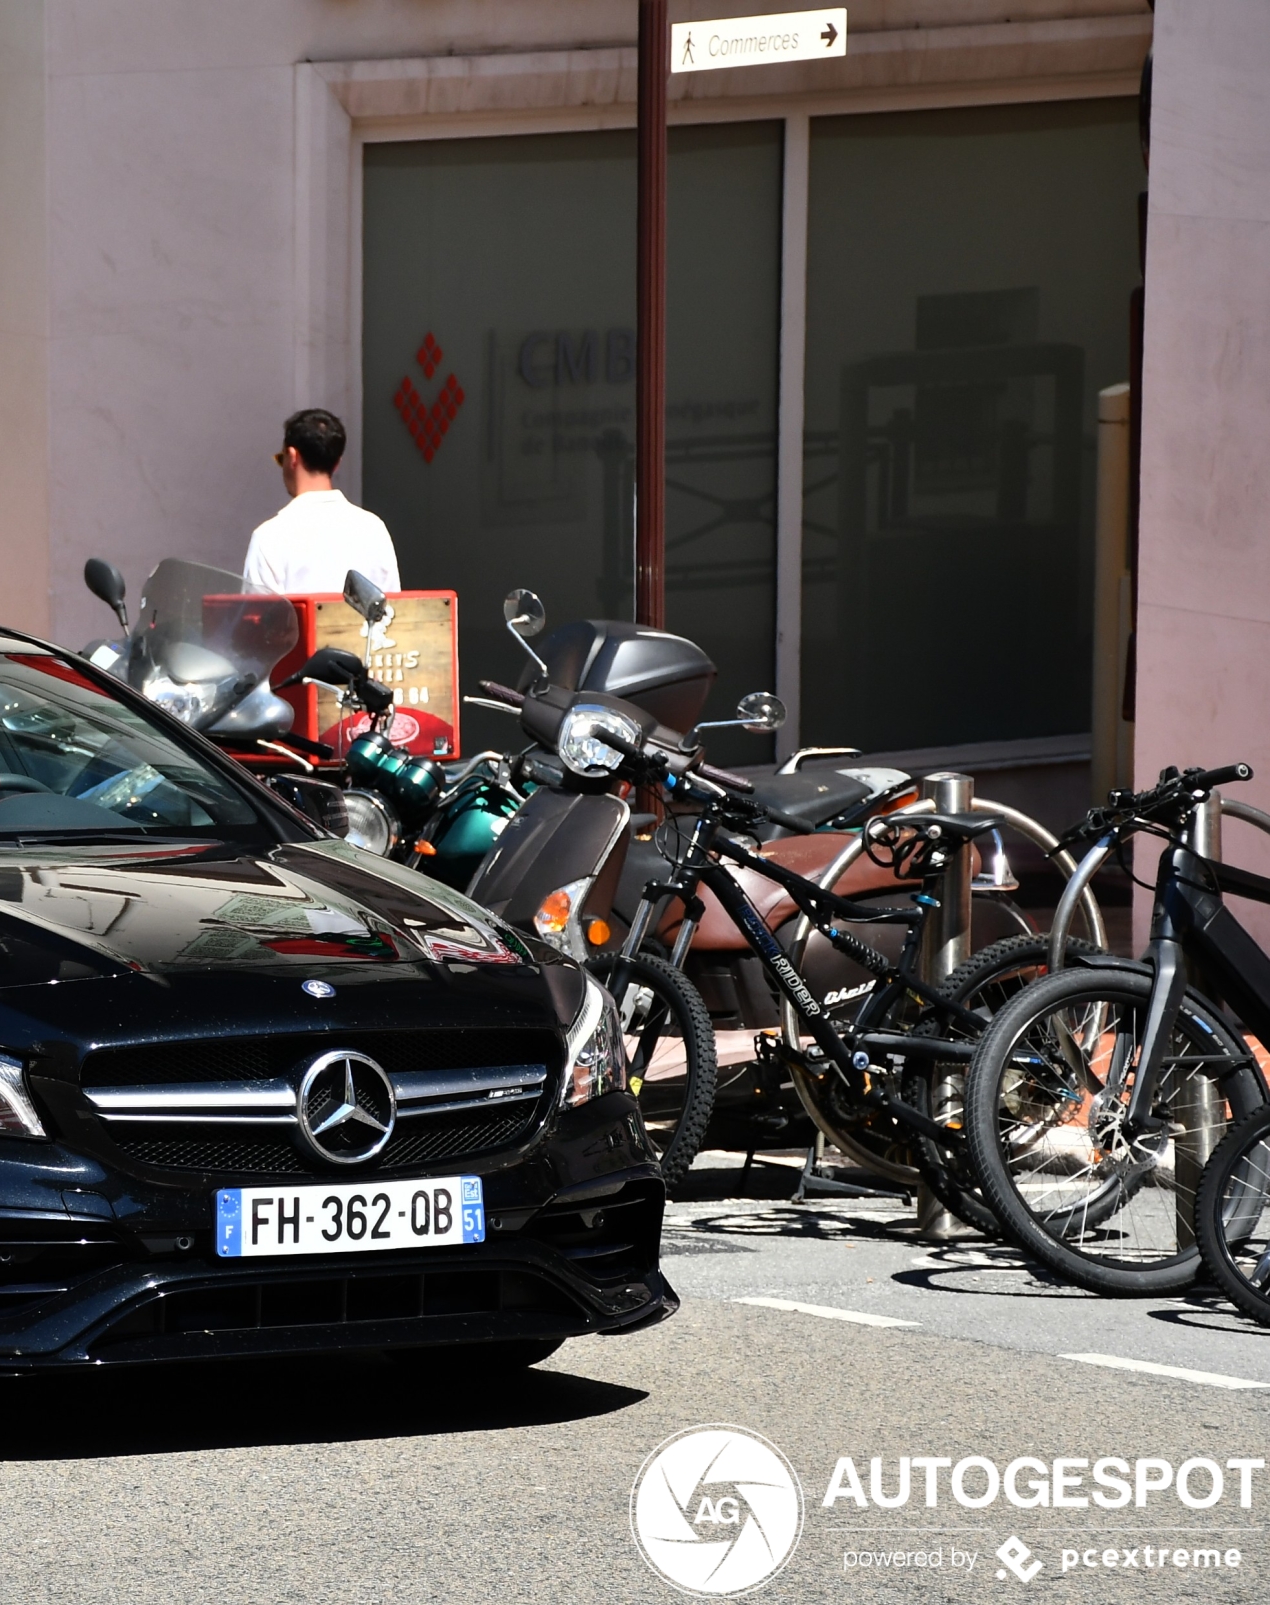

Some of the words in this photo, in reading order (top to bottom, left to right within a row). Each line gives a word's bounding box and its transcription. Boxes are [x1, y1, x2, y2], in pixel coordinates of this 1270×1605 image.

[708, 32, 800, 57] Commerces
[518, 326, 636, 389] CMB
[224, 1225, 234, 1240] F
[251, 1187, 453, 1246] FH-362-QB
[463, 1208, 482, 1232] 51
